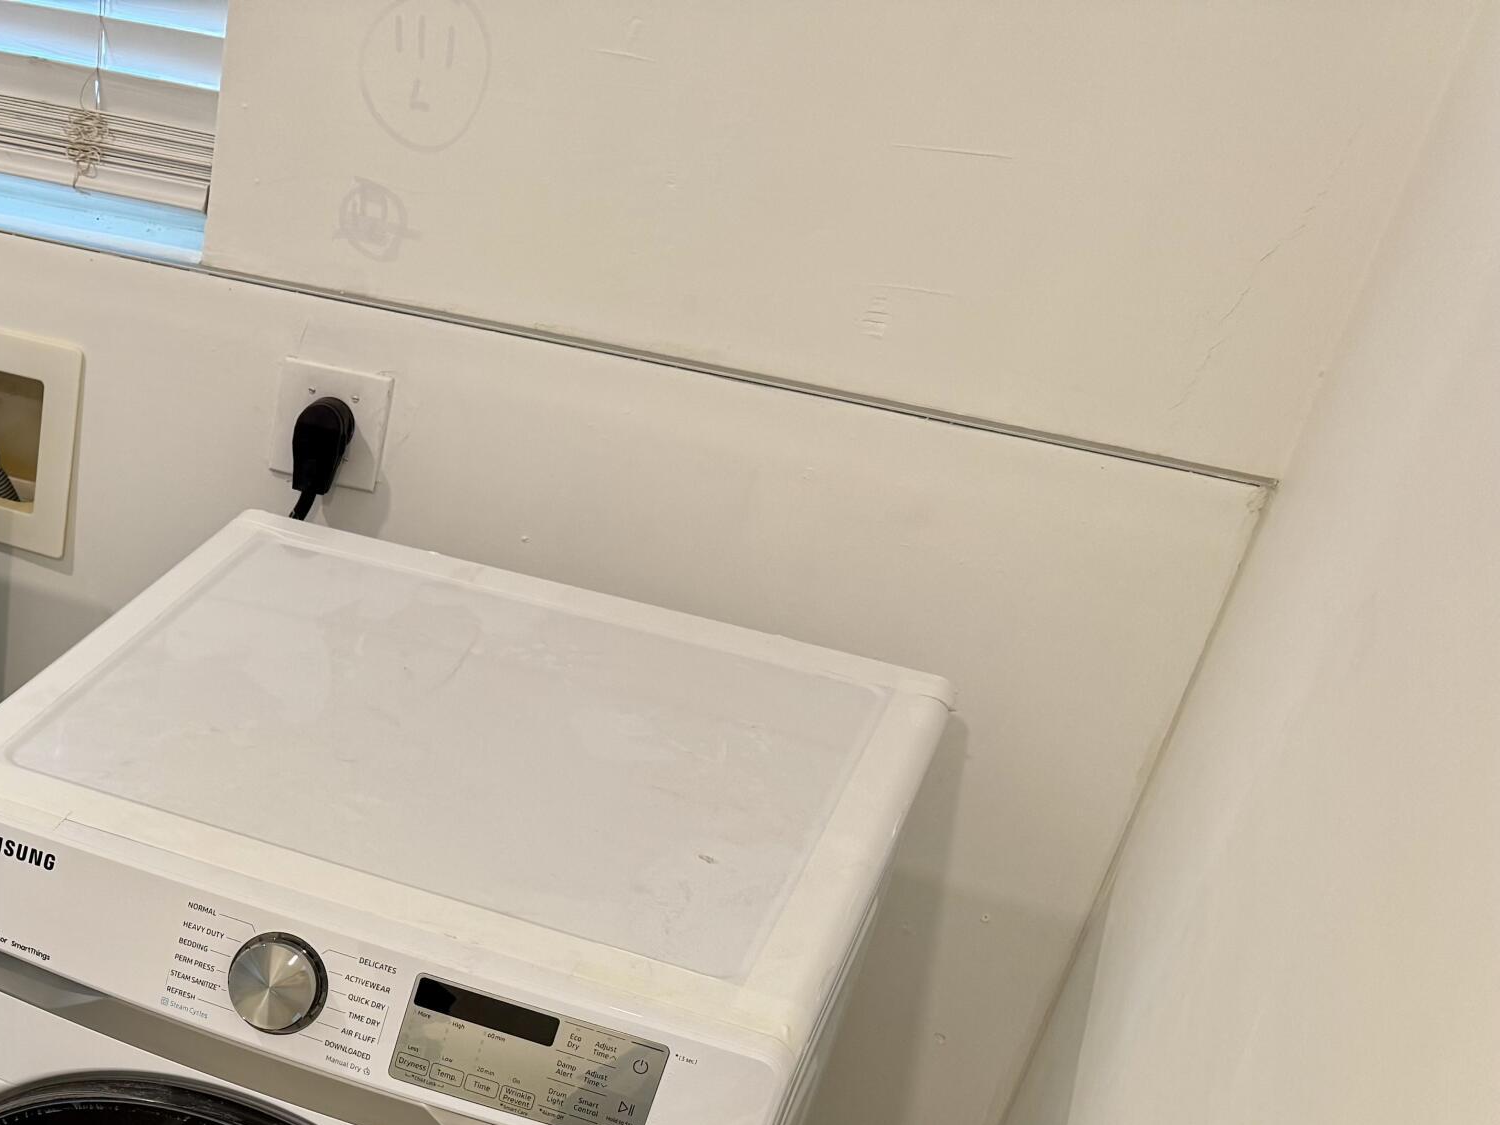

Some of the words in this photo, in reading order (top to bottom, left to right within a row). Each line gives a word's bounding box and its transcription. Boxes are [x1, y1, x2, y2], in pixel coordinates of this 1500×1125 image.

[187, 901, 217, 917] NORMAL
[183, 920, 206, 933] HEAVY
[206, 928, 225, 939] DUTY
[11, 940, 50, 961] SmartThings
[178, 936, 208, 952] BEDDING
[174, 953, 194, 965] PERM
[194, 960, 216, 973] PRESS
[359, 956, 397, 975] DELICATES
[170, 969, 191, 981] STEAM
[344, 974, 392, 994] ACTIVEWEAR
[166, 985, 196, 1000] REFRESH
[169, 999, 188, 1012] Steam
[188, 1006, 208, 1019] Cycles
[347, 993, 370, 1007] QUICK
[370, 1000, 386, 1011] DRY
[348, 1011, 365, 1023] TIME
[366, 1017, 381, 1028] DRY
[452, 1021, 465, 1030] High
[341, 1027, 353, 1036] AIR
[354, 1031, 376, 1044] FLUFF
[569, 1033, 582, 1042] Eco
[324, 1039, 371, 1061] DOWNLOADED
[567, 1040, 580, 1050] Dry
[595, 1041, 617, 1054] Adjust
[593, 1048, 610, 1060] Time
[325, 1055, 349, 1069] Manual
[350, 1061, 362, 1073] Dry
[398, 1056, 427, 1072] Dryness
[556, 1060, 577, 1072] Damp
[555, 1068, 573, 1079] Alert
[585, 1069, 608, 1081] Adjust
[474, 1080, 491, 1092] Time
[583, 1076, 600, 1087] Time
[505, 1087, 532, 1101] Wrinkle
[548, 1087, 567, 1099] Drum
[503, 1094, 530, 1109] Prevent
[546, 1096, 564, 1107] Light
[578, 1097, 599, 1109] Smart
[573, 1104, 599, 1118] Control
[605, 1115, 618, 1124] Hold
